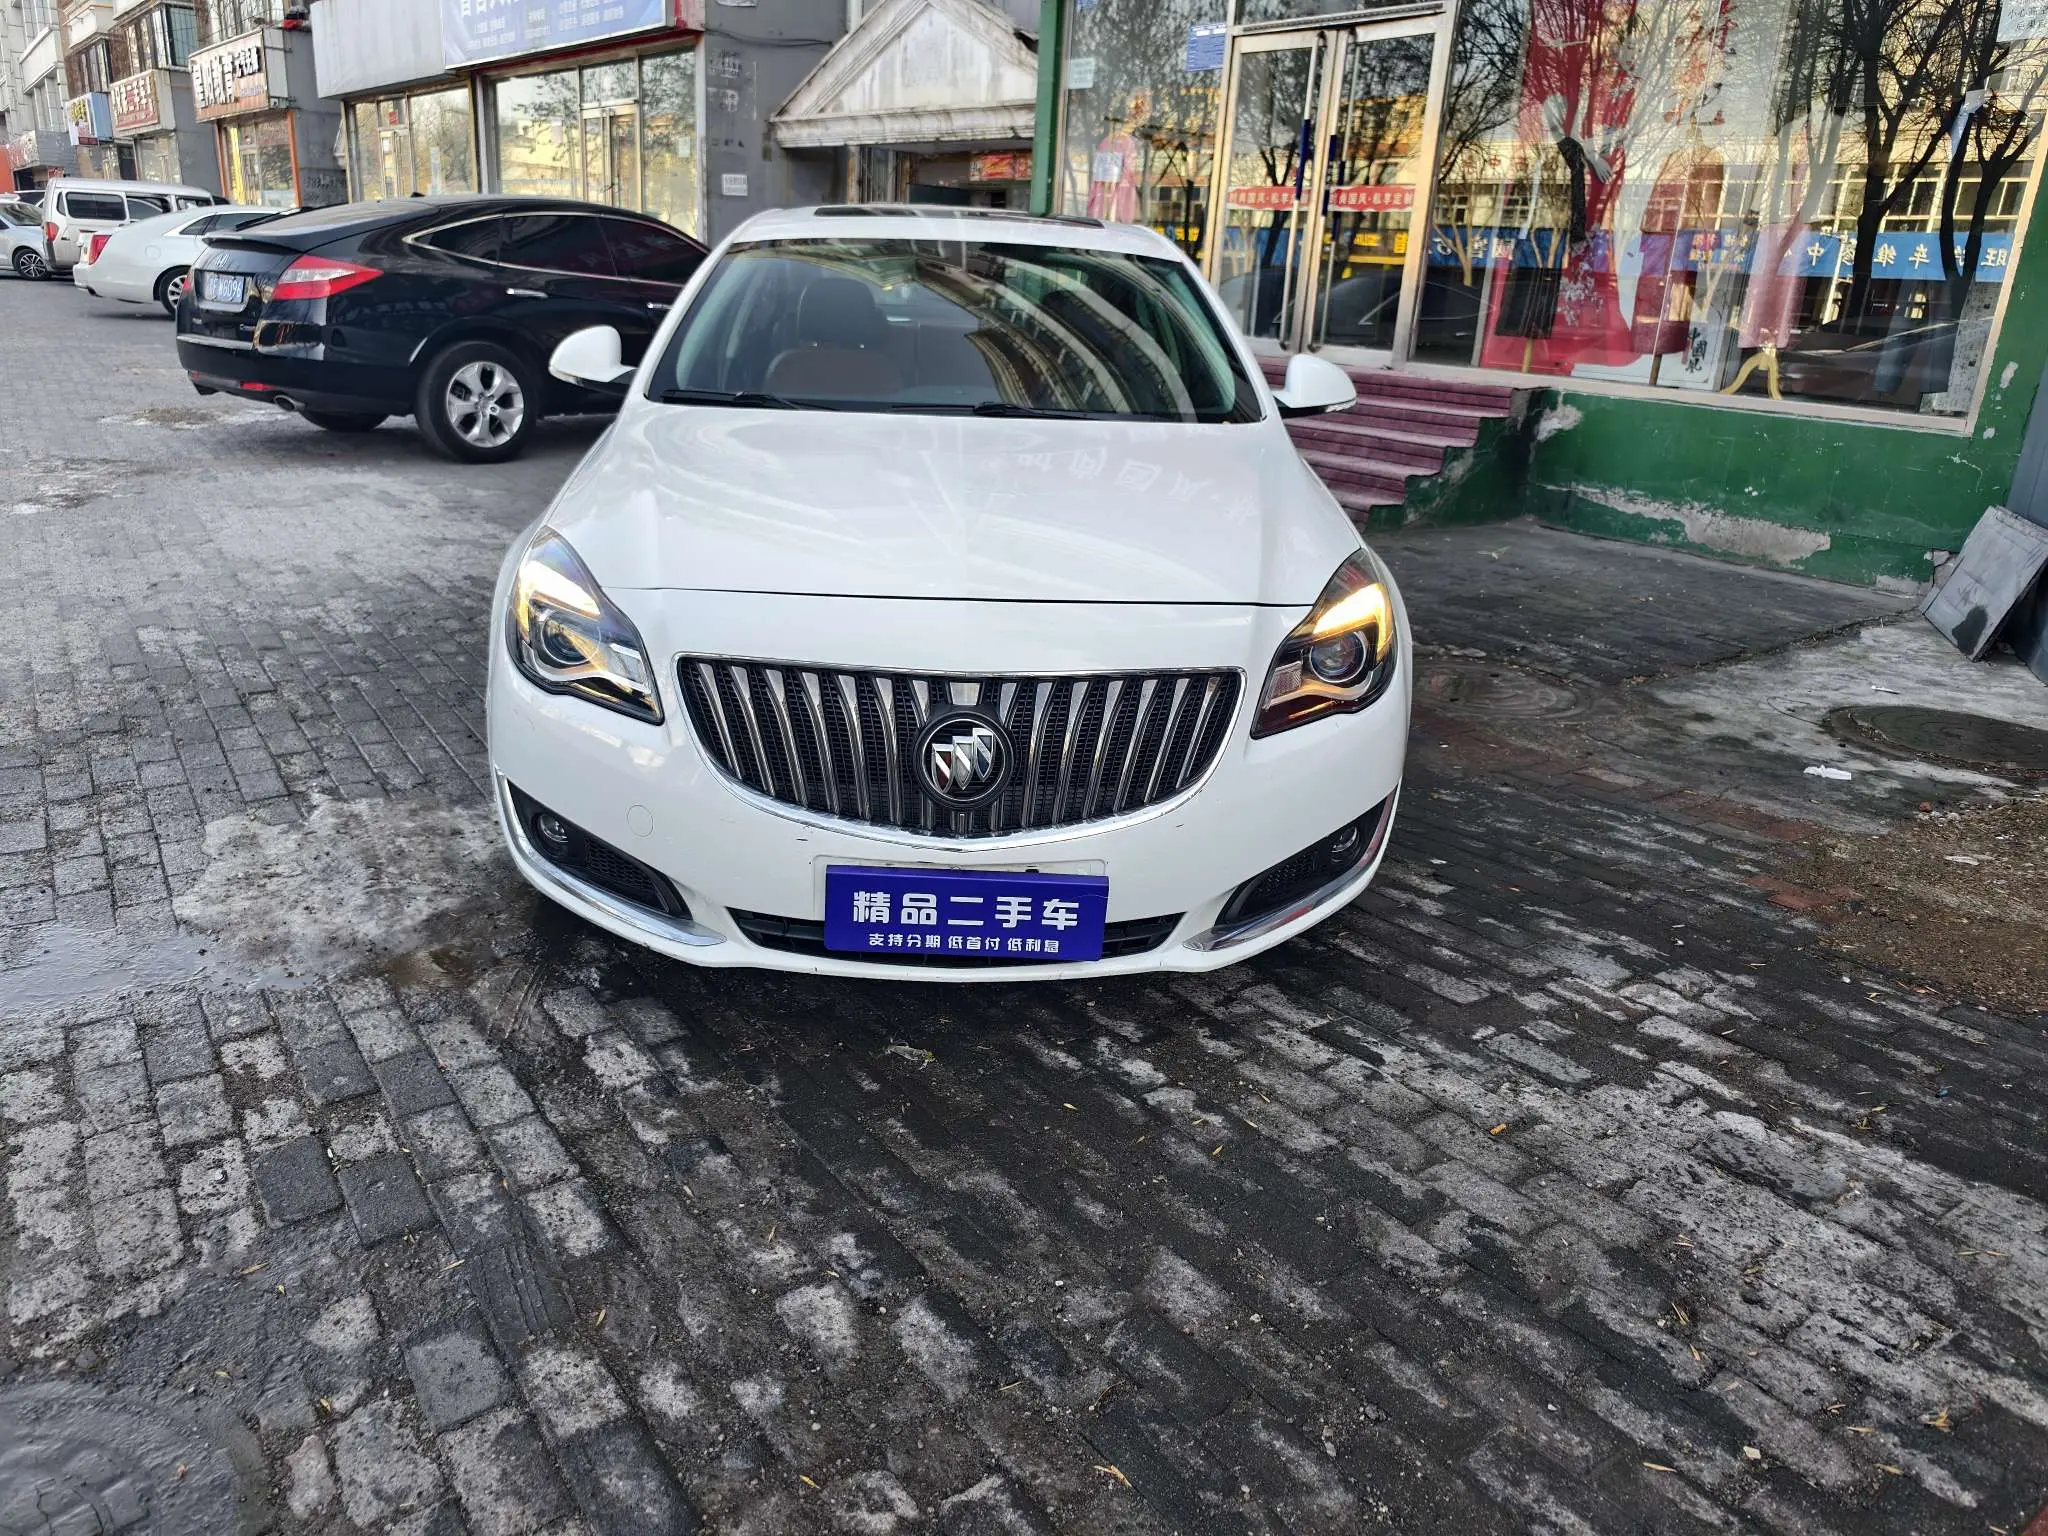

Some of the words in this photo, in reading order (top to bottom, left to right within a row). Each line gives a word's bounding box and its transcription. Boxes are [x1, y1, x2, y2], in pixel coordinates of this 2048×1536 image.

[853, 890, 1079, 930] 精品二手车
[868, 933, 941, 949] 支持分期
[948, 934, 1001, 951] 低首付
[1007, 937, 1059, 953] 低利息
